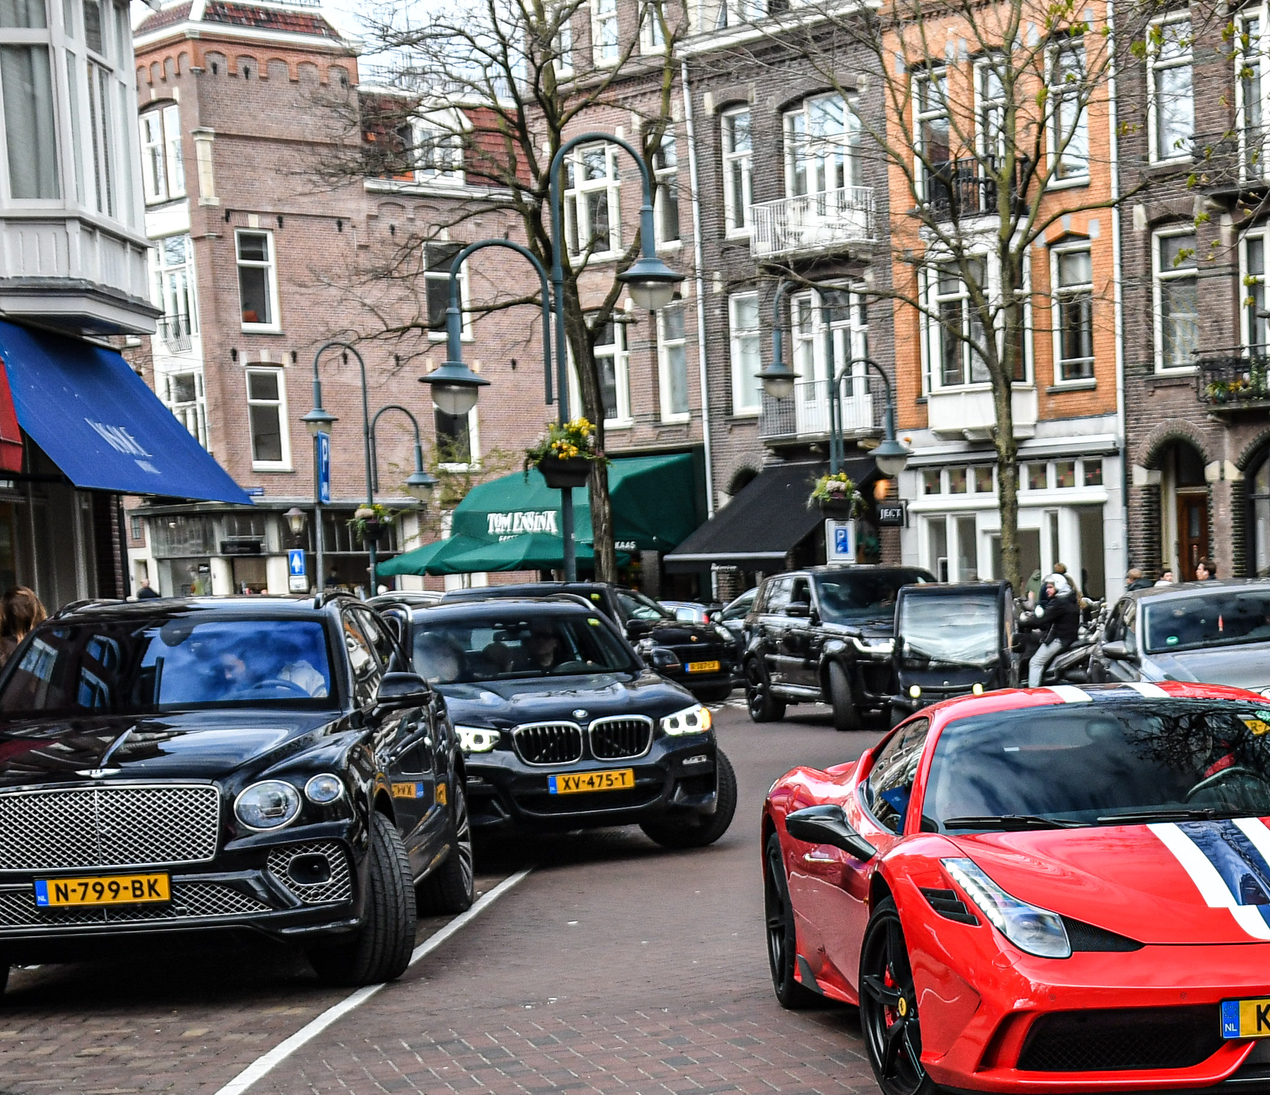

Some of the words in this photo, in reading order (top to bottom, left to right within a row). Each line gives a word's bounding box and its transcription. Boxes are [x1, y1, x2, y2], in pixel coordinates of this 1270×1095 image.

[614, 541, 637, 549] KAAS
[562, 772, 627, 791] XV-475-T
[54, 878, 161, 902] N-799-BK
[1224, 1023, 1238, 1032] NL
